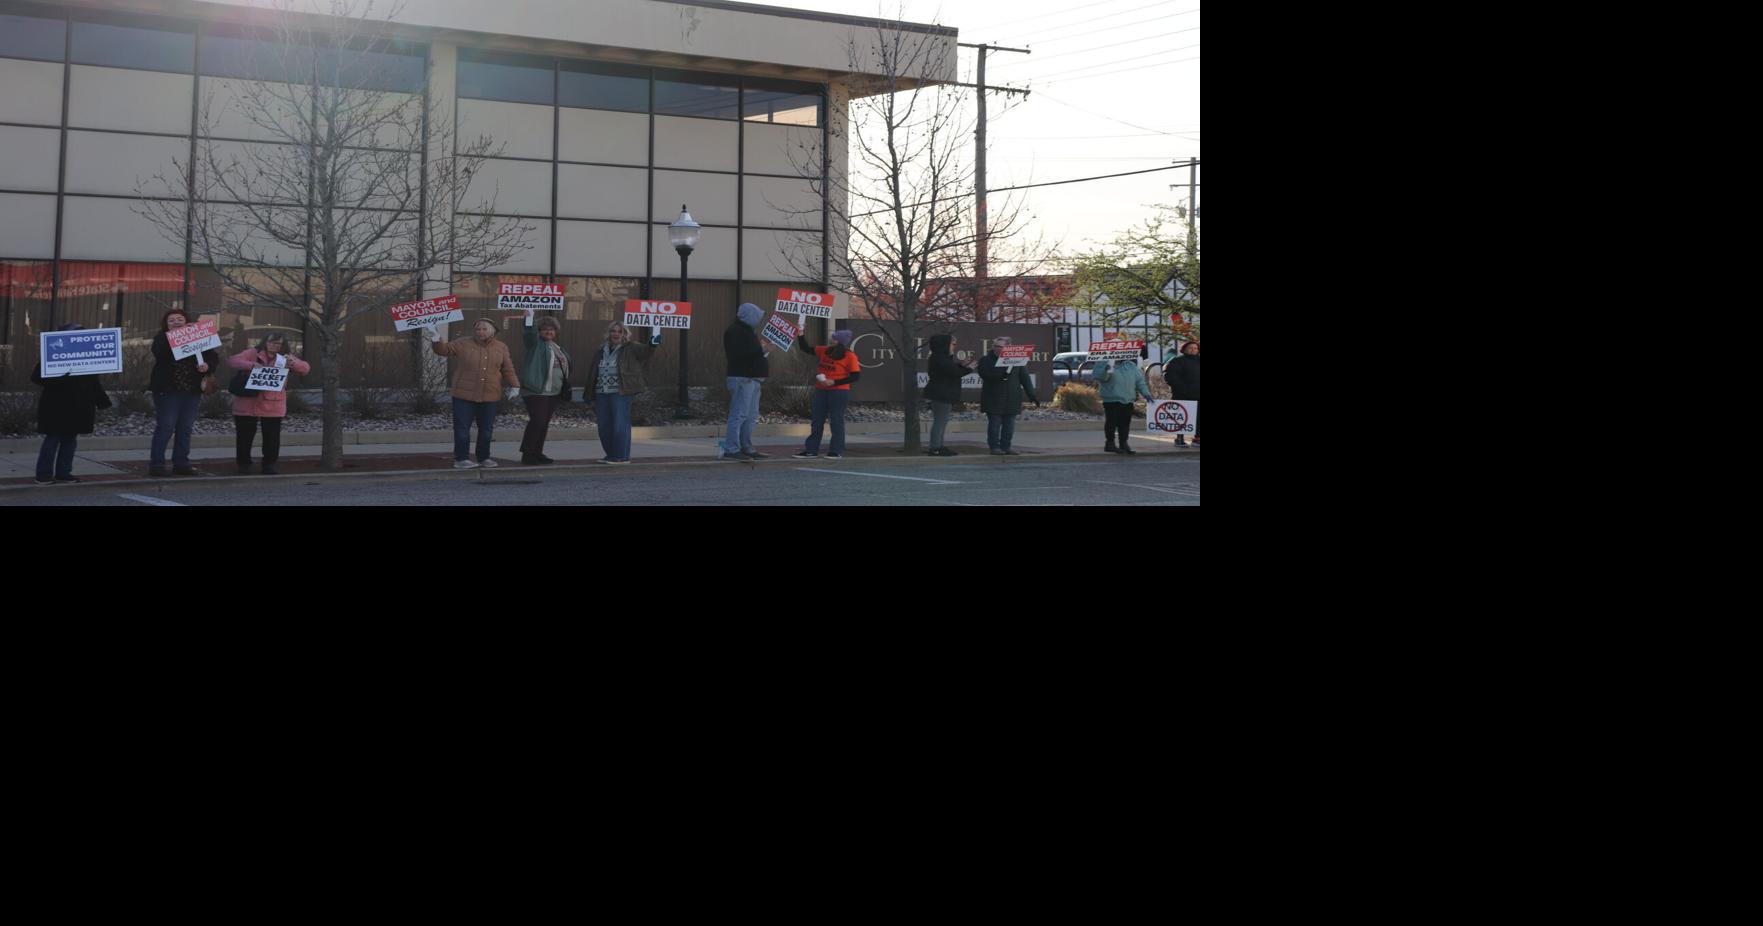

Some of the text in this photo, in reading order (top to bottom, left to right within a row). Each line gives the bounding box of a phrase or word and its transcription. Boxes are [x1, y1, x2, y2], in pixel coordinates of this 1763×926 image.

[502, 284, 562, 295] REPEAL
[791, 291, 822, 304] NO
[392, 297, 456, 313] MAYOR and
[640, 301, 677, 314] NO
[778, 301, 830, 316] DATA CENTER
[399, 305, 454, 319] COUNCIL
[407, 312, 451, 327] Resign!
[627, 314, 688, 327] DATA CENTER
[770, 314, 797, 338] REPEAL
[166, 324, 198, 339] MAYOR
[175, 329, 216, 345] COUNCIL
[766, 325, 792, 344] AMAZON
[70, 334, 115, 343] PROTECT
[94, 342, 115, 350] OUR
[1091, 342, 1141, 350] REPEAL
[52, 349, 115, 359] COMMUNITY
[251, 373, 285, 381] SECRET
[1148, 422, 1194, 432] CENTERS
